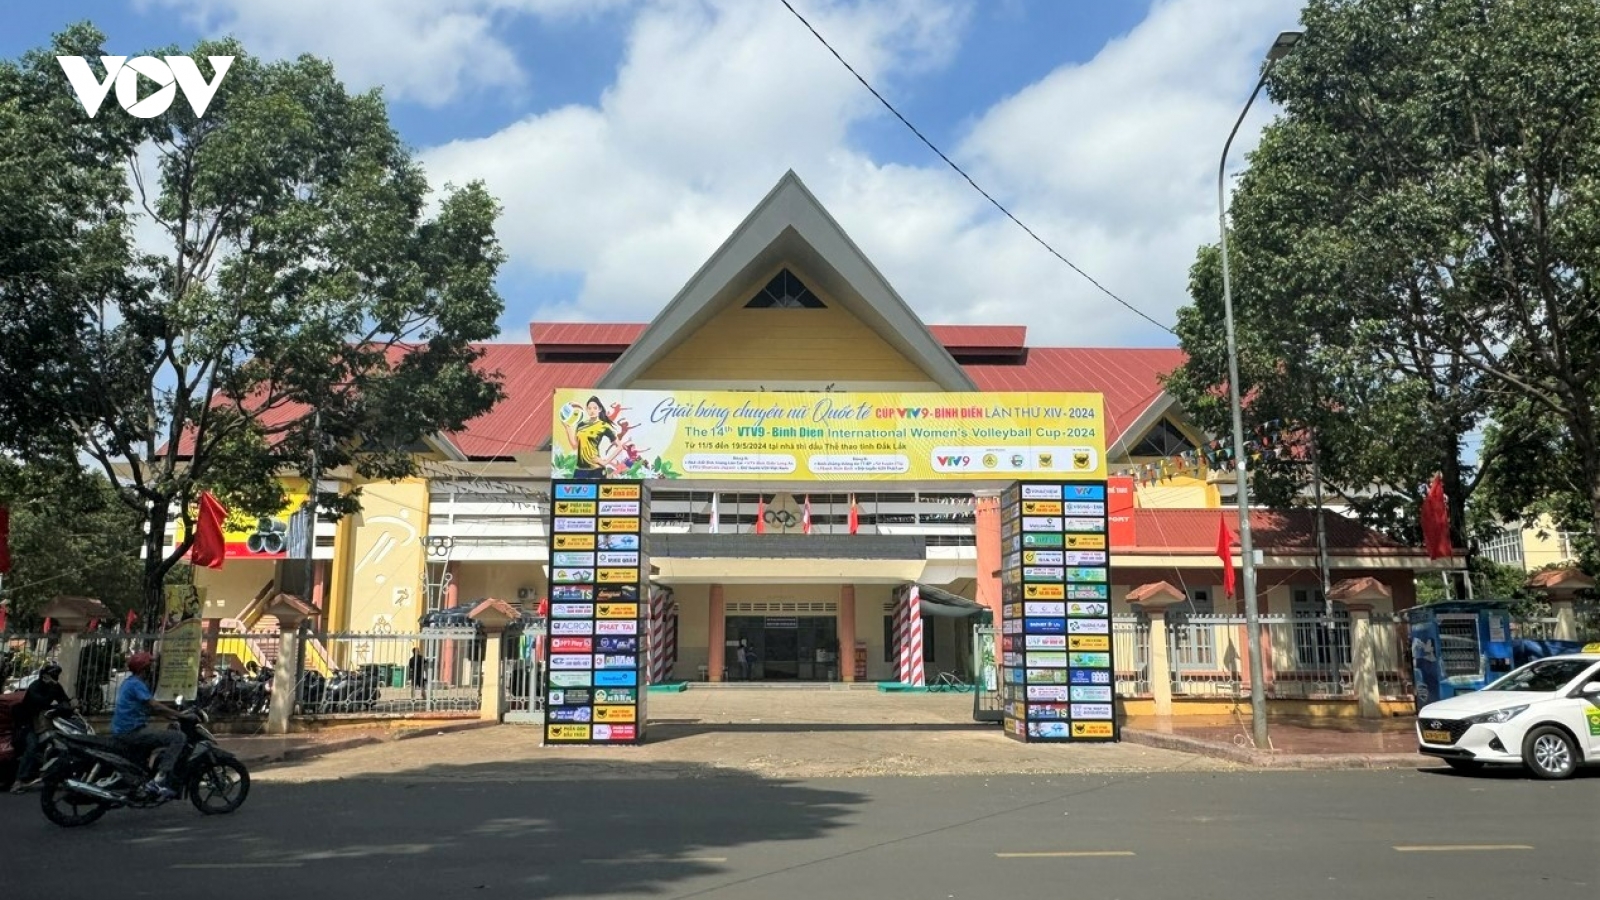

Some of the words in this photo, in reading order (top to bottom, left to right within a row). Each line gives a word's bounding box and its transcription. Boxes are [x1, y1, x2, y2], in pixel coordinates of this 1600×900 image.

[694, 399, 731, 428] bóng
[875, 405, 896, 419] CÚP
[685, 426, 708, 437] The
[711, 425, 733, 437] 14th
[771, 426, 797, 438] Binh
[799, 427, 824, 438] Dien
[827, 428, 907, 439] International
[910, 428, 969, 438] Women's
[972, 428, 1032, 441] Volleyball
[714, 441, 729, 450] đến
[731, 442, 767, 450] 19/5/2024
[768, 442, 779, 451] tại
[779, 442, 795, 450] nhà
[825, 442, 840, 451] Thể
[840, 442, 858, 451] thao
[937, 456, 970, 467] VTV9
[563, 486, 589, 494] VTV9
[1075, 487, 1094, 495] VTV
